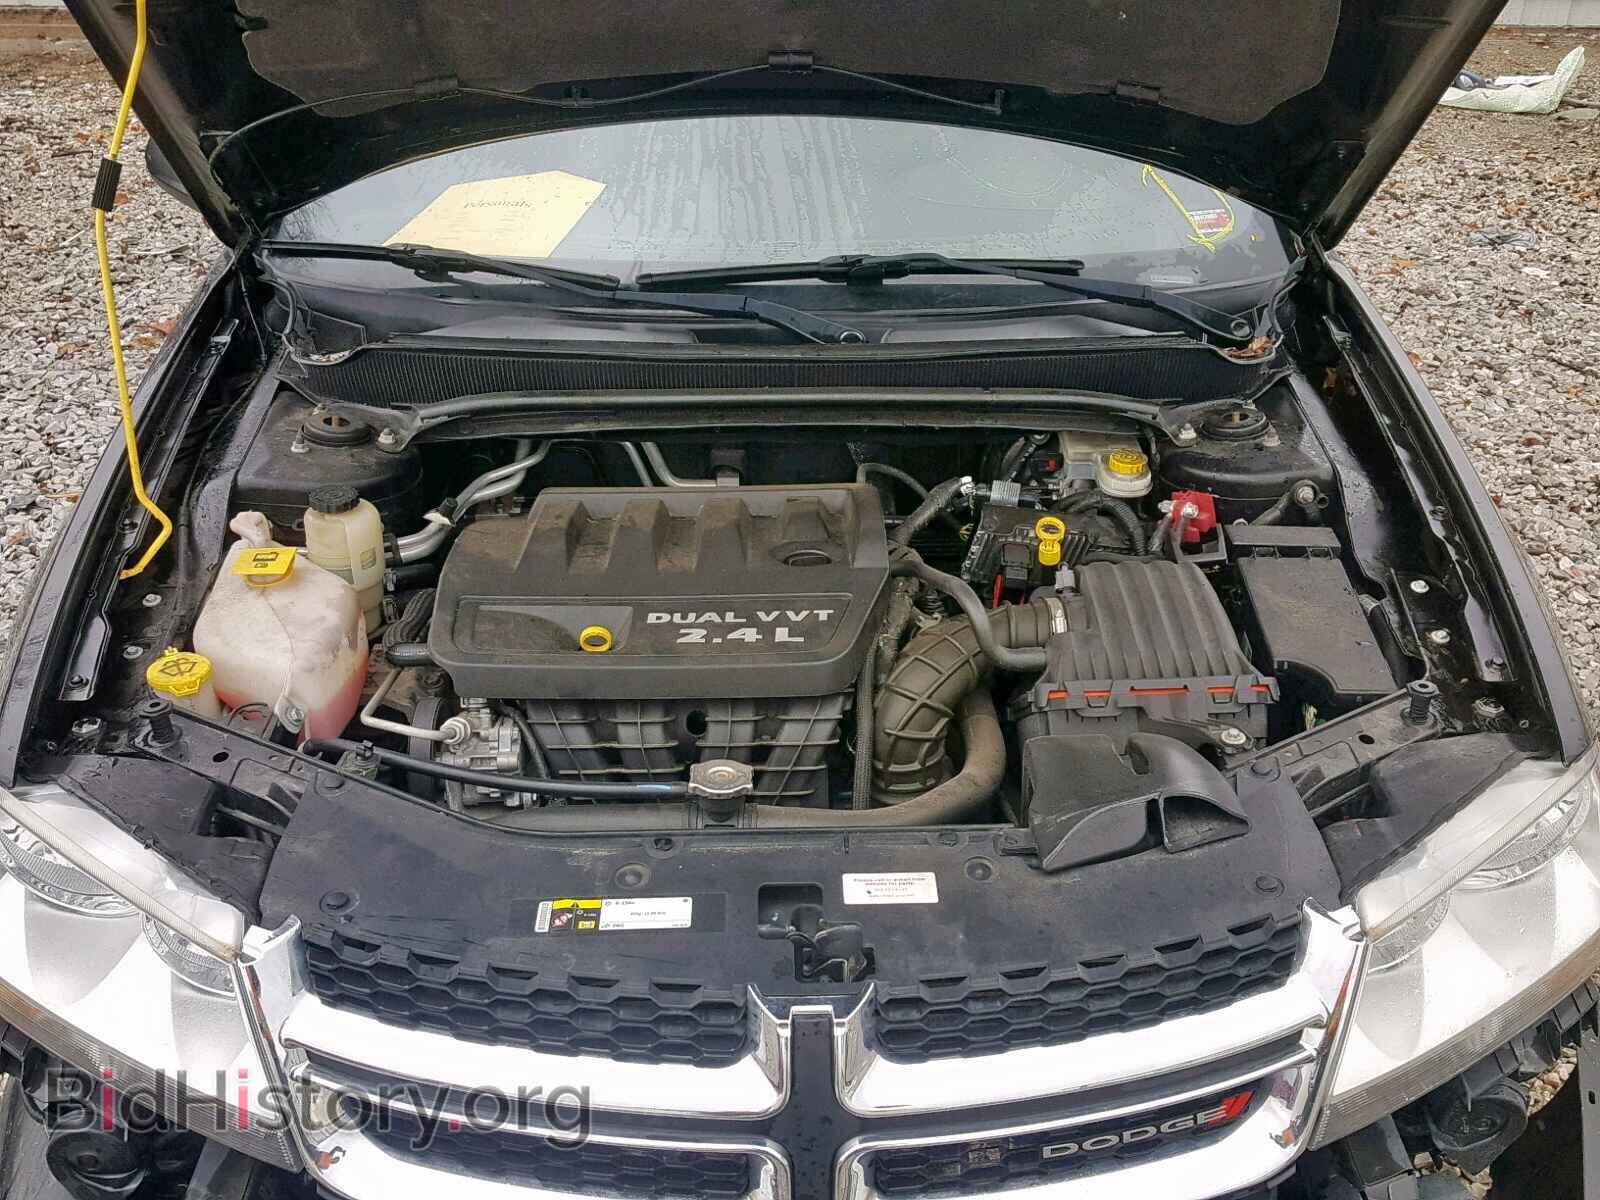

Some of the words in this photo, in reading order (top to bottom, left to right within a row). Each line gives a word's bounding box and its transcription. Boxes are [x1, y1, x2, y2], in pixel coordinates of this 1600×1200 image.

[646, 612, 747, 624] DUAL
[756, 609, 835, 622] VVT
[676, 627, 763, 643] 2.4
[774, 626, 805, 642] L
[1042, 1107, 1227, 1159] DODGE
